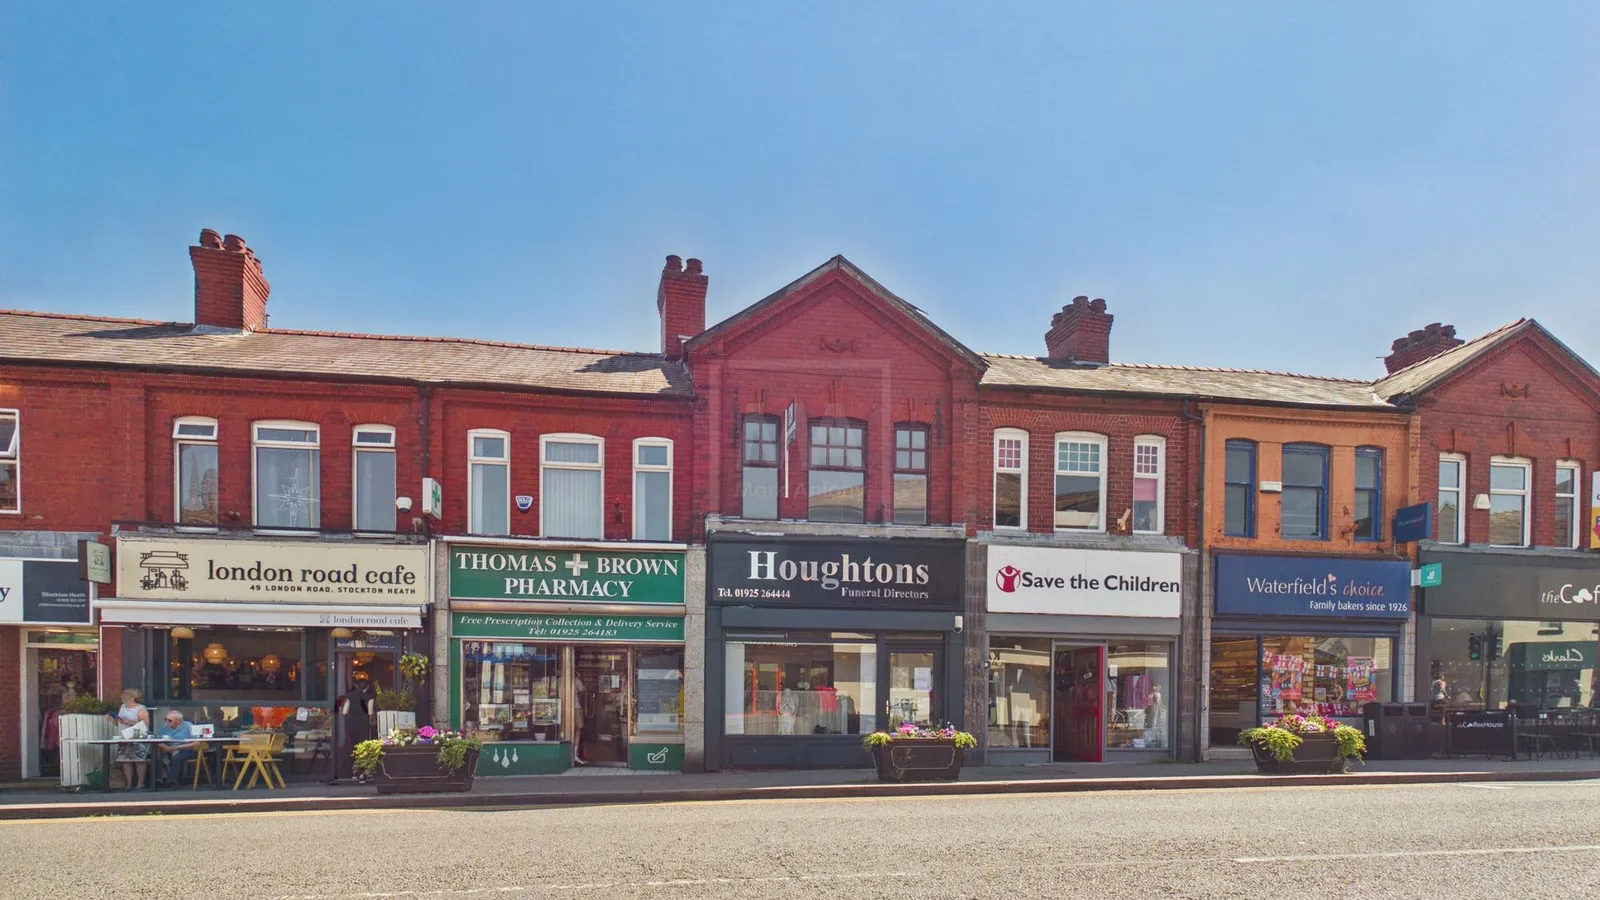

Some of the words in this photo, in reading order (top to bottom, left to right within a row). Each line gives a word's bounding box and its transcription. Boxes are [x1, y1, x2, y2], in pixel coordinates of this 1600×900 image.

[456, 552, 557, 572] THOMAS
[596, 557, 679, 576] BROWN
[747, 550, 930, 590] Houghtons
[208, 560, 293, 582] london
[300, 564, 359, 584] road
[365, 565, 416, 584] cafe
[504, 578, 633, 598] PHARMACY
[1022, 571, 1065, 588] Save
[1070, 574, 1099, 590] the
[1104, 575, 1180, 593] Children
[1342, 580, 1385, 597] choice
[718, 588, 733, 598] Tel.
[734, 588, 759, 598] 01925
[761, 589, 791, 599] 264444
[841, 587, 881, 598] Funeral
[884, 588, 929, 599] Directors
[1310, 601, 1336, 612] Family
[1337, 601, 1364, 611] bakers
[1365, 603, 1386, 612] since
[1388, 603, 1408, 612] 1926
[333, 616, 364, 624] london
[366, 616, 389, 625] road
[389, 616, 409, 625] cafe
[460, 616, 482, 625] Free
[483, 616, 543, 628] Prescription
[545, 618, 593, 627] Collection
[595, 619, 603, 627] &
[605, 619, 644, 630] Delivery
[646, 620, 678, 629] Service
[528, 627, 547, 636] Tel:
[549, 628, 580, 636] 01925
[581, 629, 618, 637] 264183
